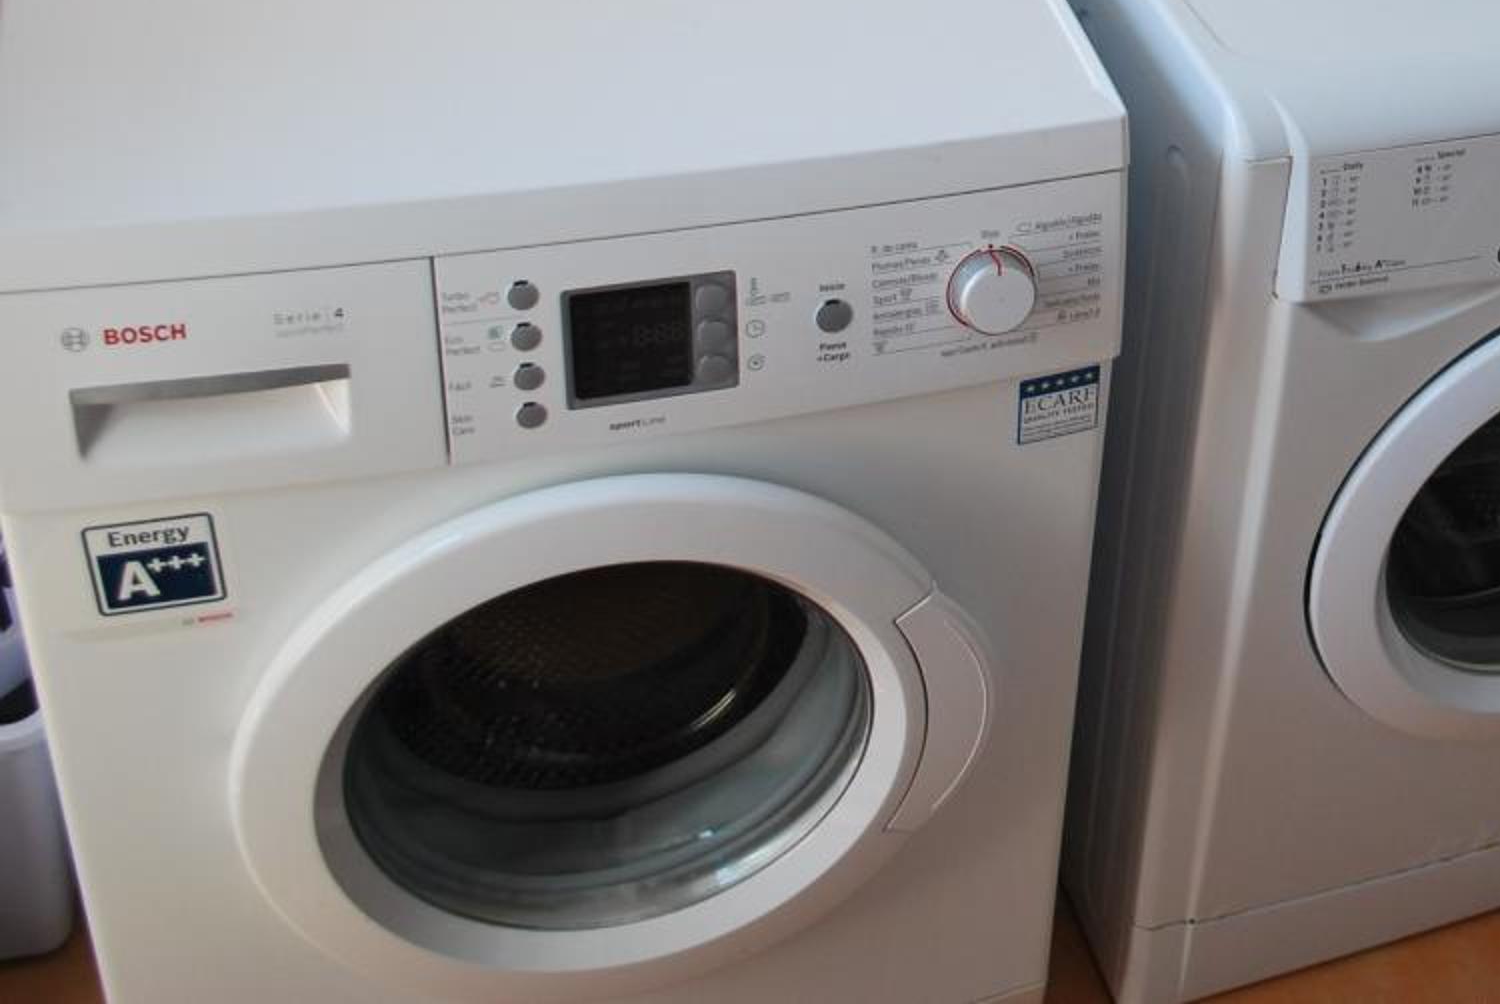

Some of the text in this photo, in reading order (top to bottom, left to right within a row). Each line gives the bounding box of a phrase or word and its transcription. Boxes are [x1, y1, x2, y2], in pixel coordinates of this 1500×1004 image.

[334, 307, 345, 319] 4
[103, 323, 188, 346] BOSCH
[107, 525, 190, 548] Energy
[117, 552, 206, 601] A+++
